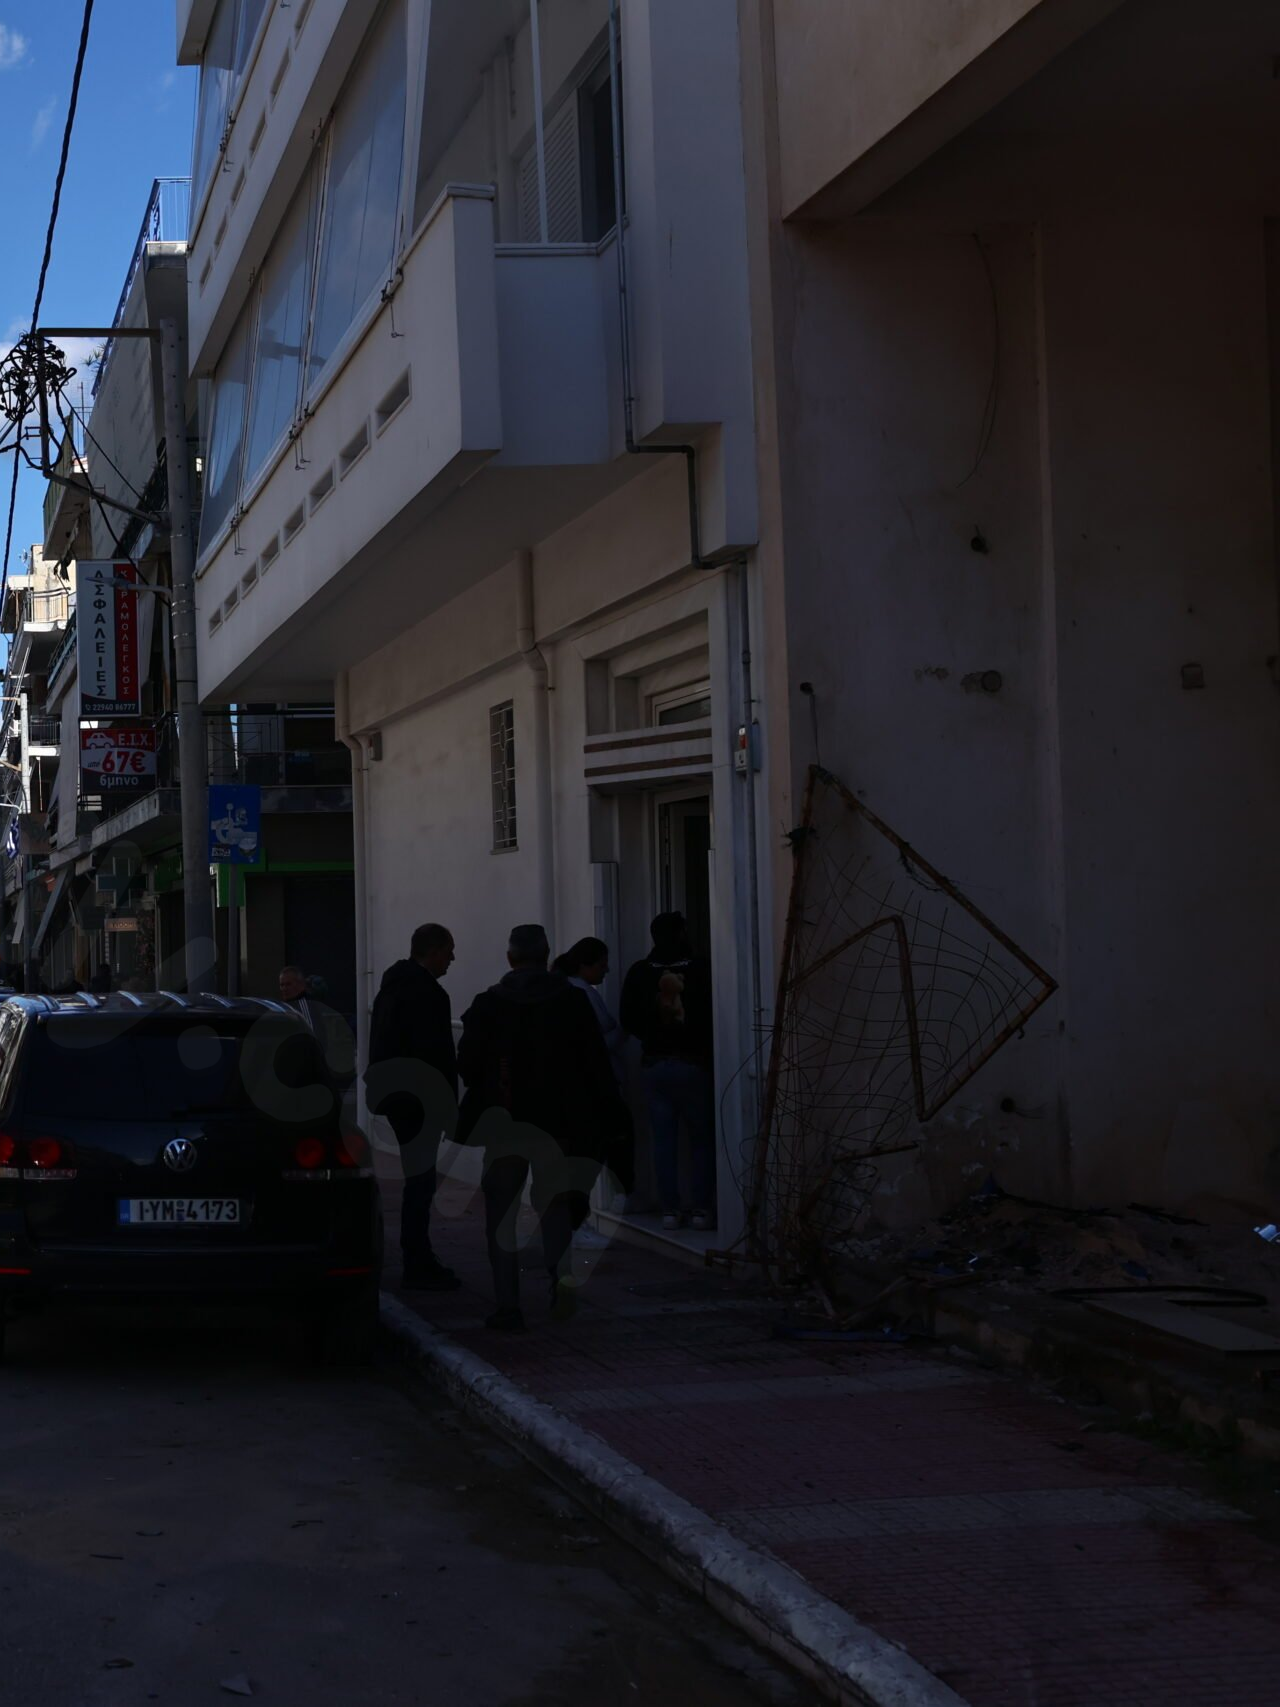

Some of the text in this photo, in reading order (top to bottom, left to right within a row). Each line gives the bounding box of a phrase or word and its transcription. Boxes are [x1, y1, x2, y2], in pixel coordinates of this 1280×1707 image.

[94, 569, 107, 697] ΑΣΦΑΛΕΙΕΣ
[119, 569, 131, 695] ΚΡΑΜΟΛΕΓΚΟΣ
[92, 703, 114, 712] 22940
[102, 751, 146, 774] 67€
[99, 774, 139, 790] 6μηνο
